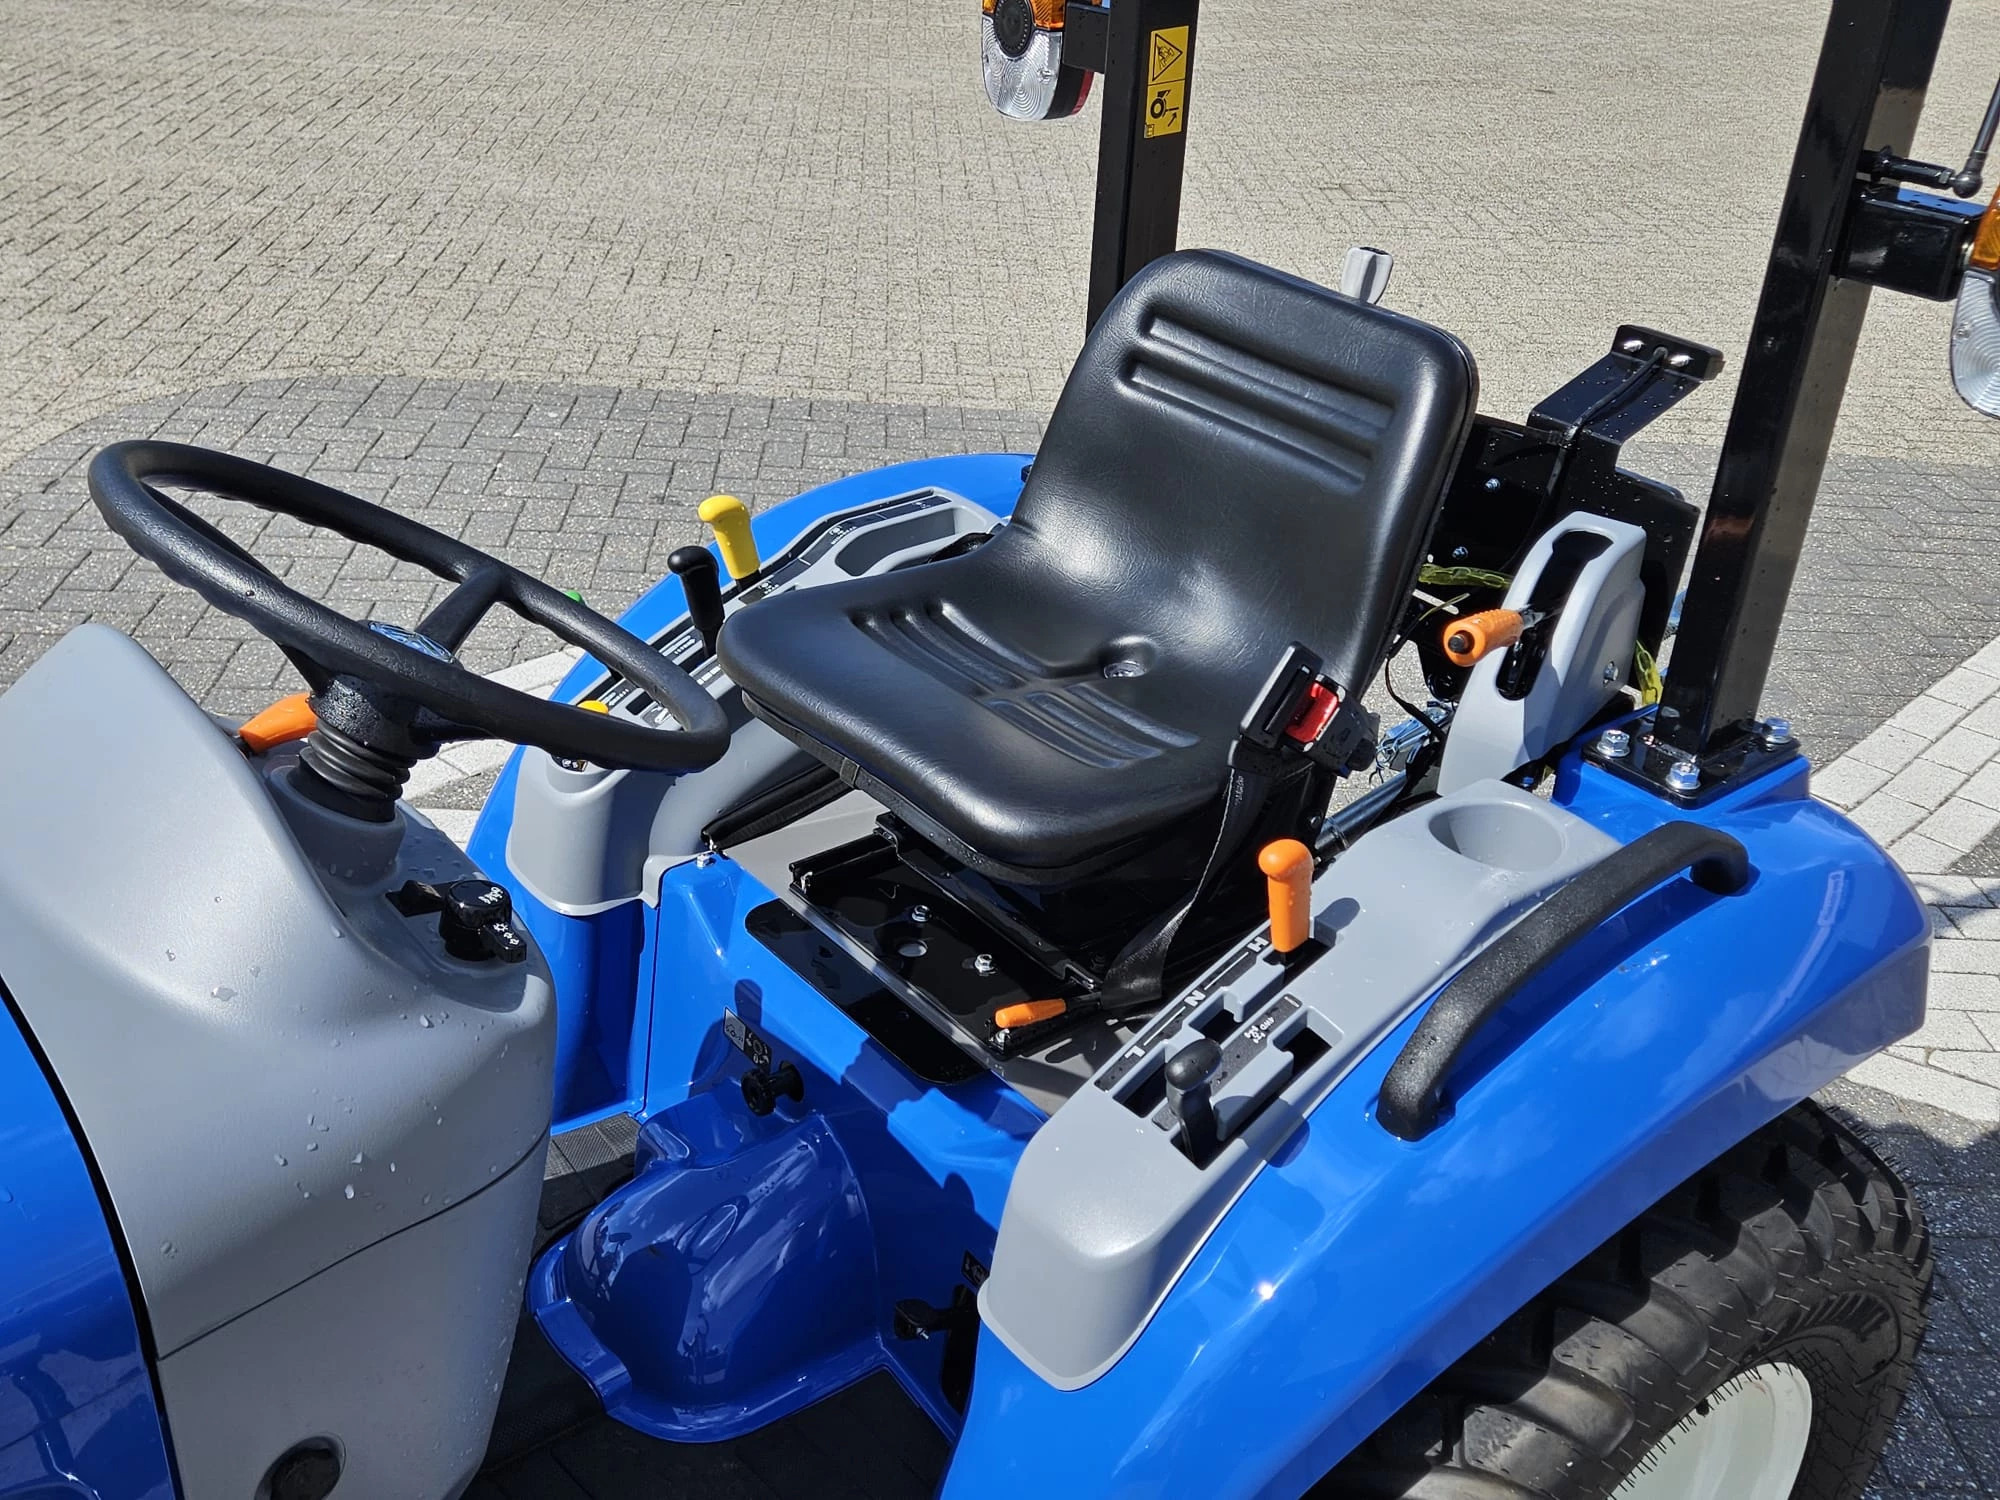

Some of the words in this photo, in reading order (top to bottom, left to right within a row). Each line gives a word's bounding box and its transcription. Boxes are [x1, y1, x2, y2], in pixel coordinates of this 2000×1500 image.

[1248, 937, 1268, 952] H
[1185, 990, 1206, 1007] N
[1259, 1016, 1275, 1031] 4WD
[1125, 1045, 1146, 1060] L
